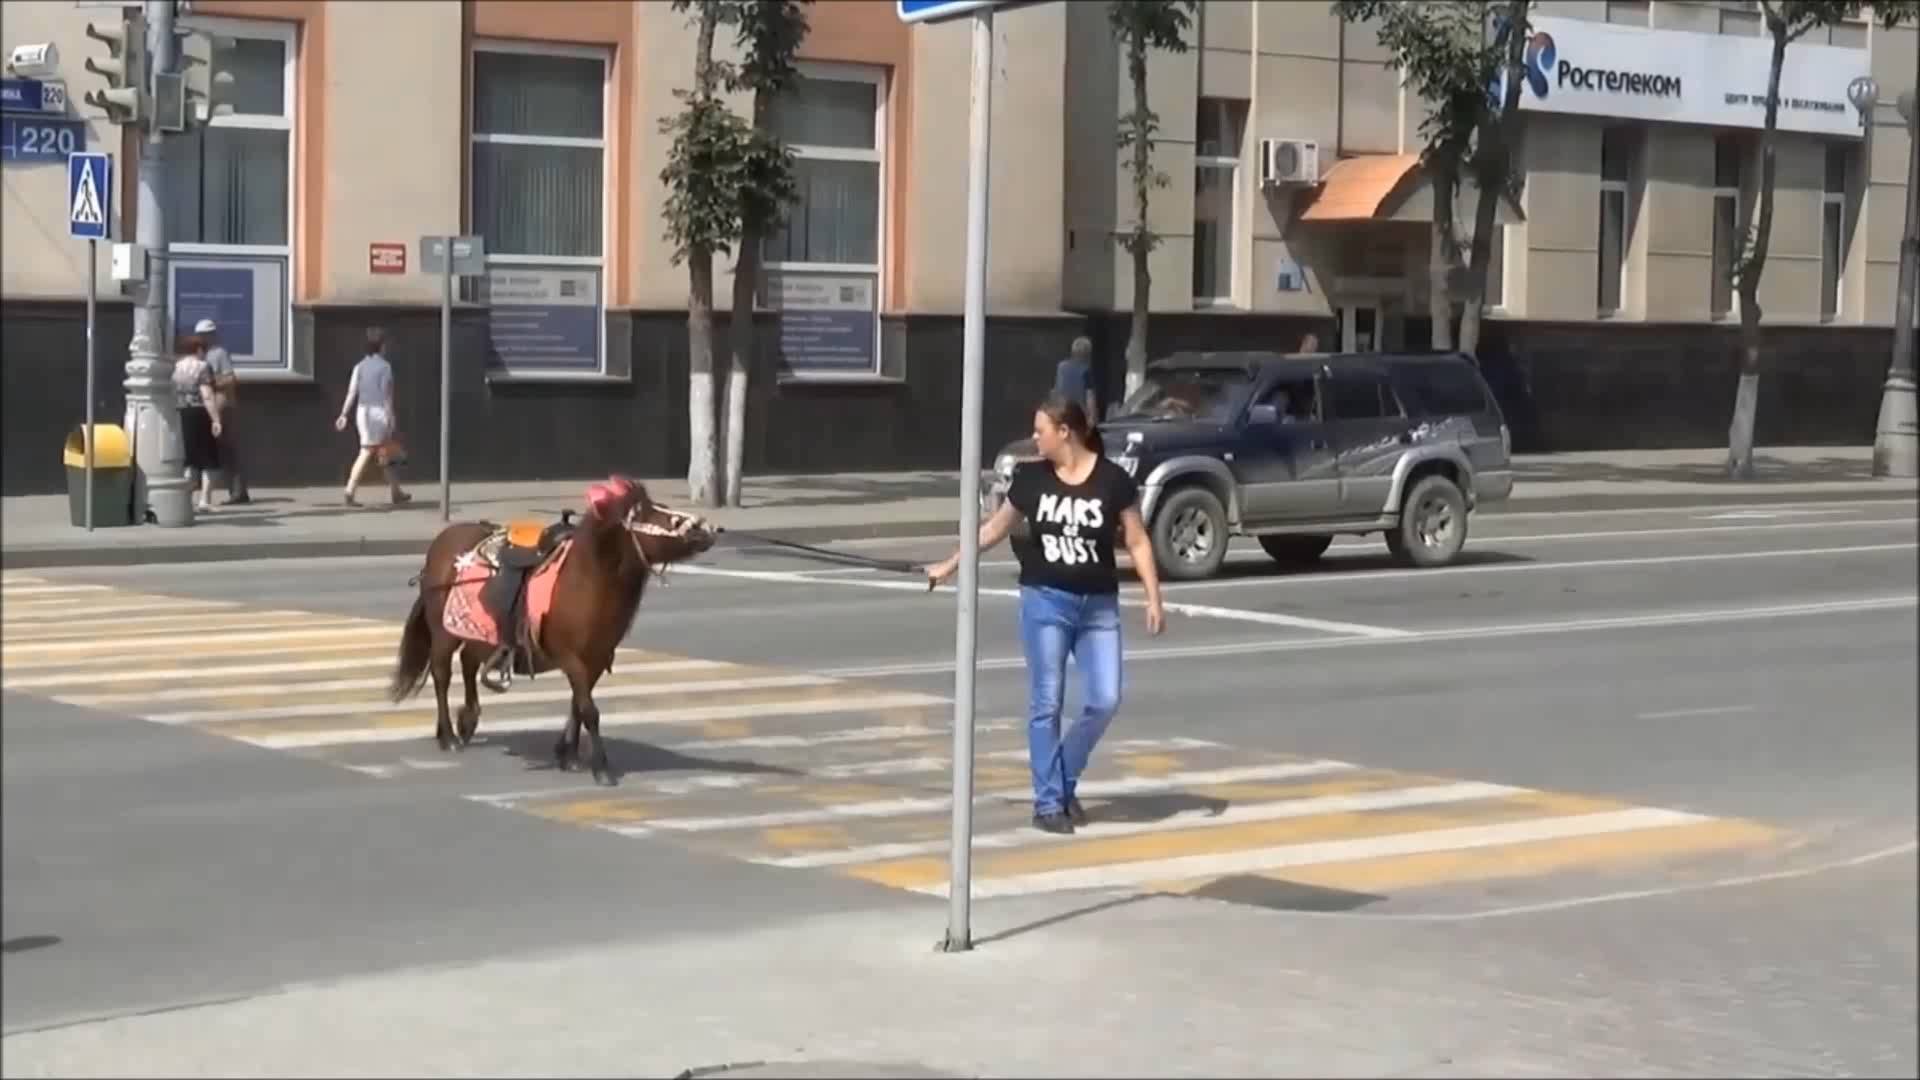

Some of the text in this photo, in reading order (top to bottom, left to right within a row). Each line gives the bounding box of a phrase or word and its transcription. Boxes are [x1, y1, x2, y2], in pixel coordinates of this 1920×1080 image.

[43, 86, 64, 104] 220
[1558, 59, 1682, 99] Ростелеком
[21, 126, 76, 154] 220
[1036, 493, 1104, 528] MARS
[1041, 534, 1099, 566] BUST
